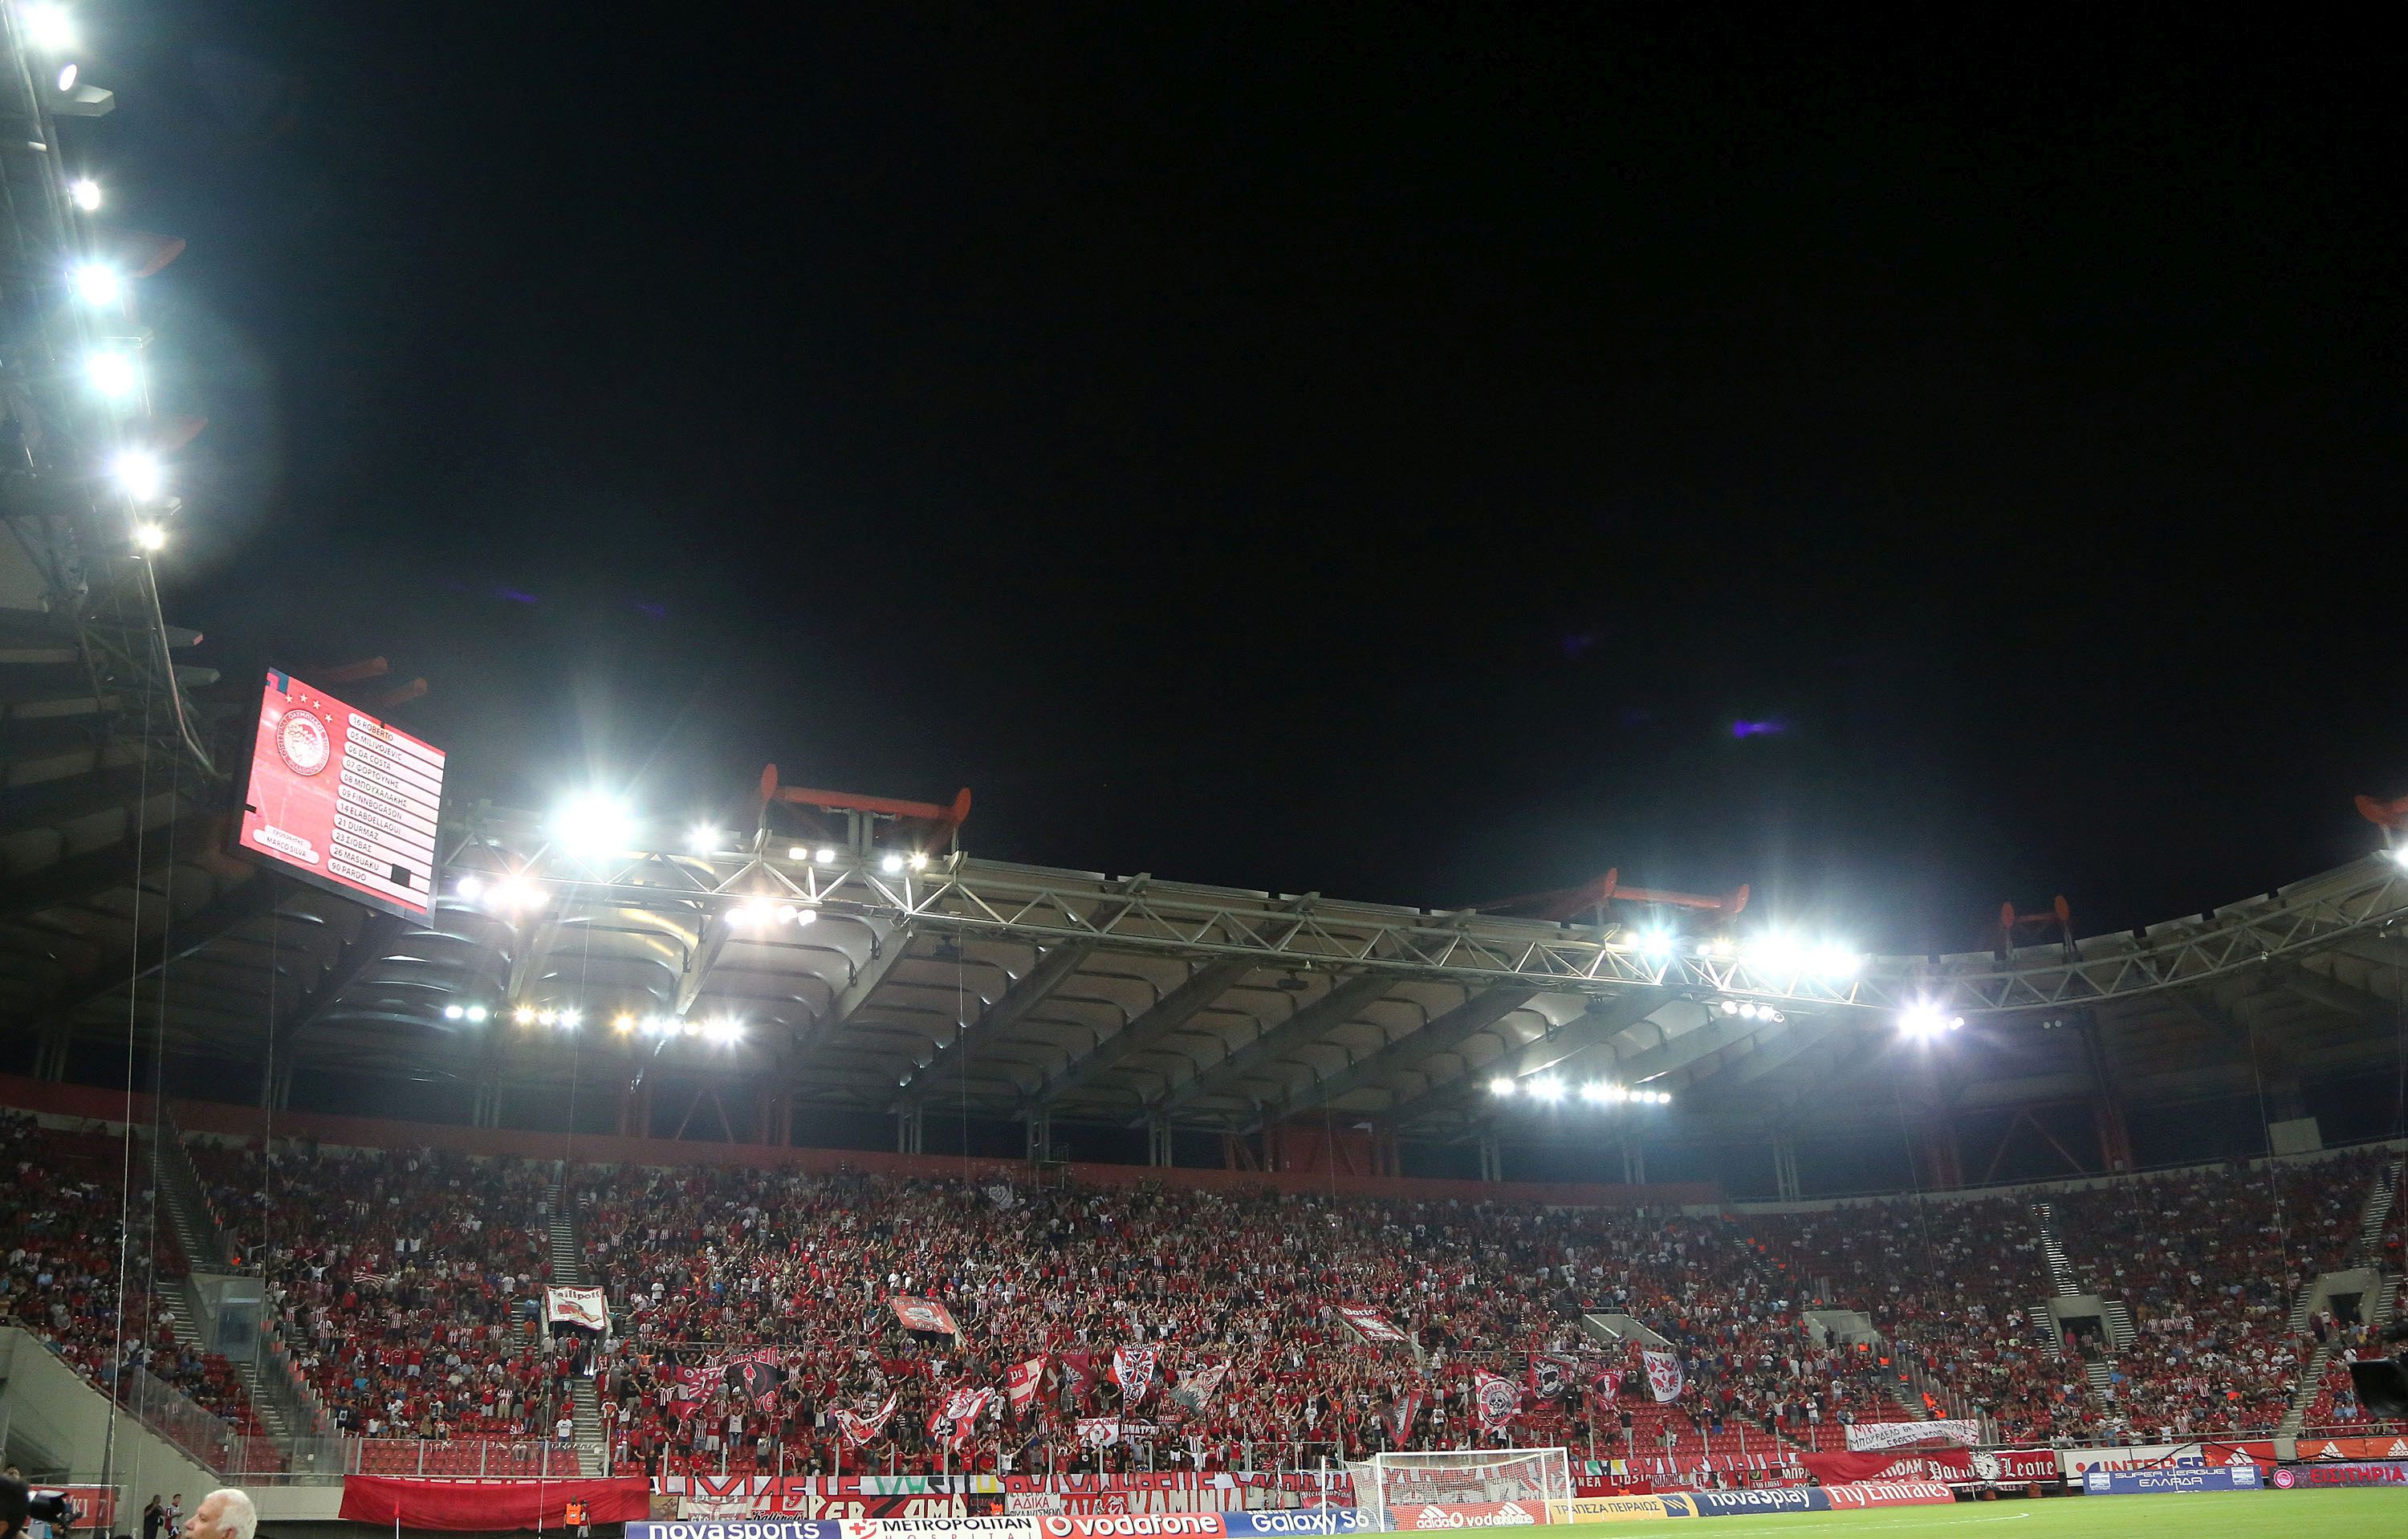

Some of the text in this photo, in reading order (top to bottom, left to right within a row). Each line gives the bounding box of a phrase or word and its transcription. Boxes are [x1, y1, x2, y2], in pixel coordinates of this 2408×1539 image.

[353, 717, 394, 742] 16 ROBERTO
[350, 731, 403, 761] 05 MILIVOJEVIC
[348, 745, 357, 755] 06
[369, 754, 392, 770] COSTA
[342, 788, 403, 820] 09 FINNBOGASON
[338, 818, 379, 841] 21 DURMAZ
[340, 803, 402, 835] 14 ELABDELLAOUI
[266, 837, 307, 858] MARCO SILVA
[336, 833, 372, 853] 23 ΣΙΟΒΑΣ
[333, 847, 380, 871] 26 MASUAKU
[332, 862, 367, 881] 90 PARDO
[2000, 1457, 2056, 1478] Leone
[2115, 1471, 2163, 1479] SUPER
[2311, 1466, 2406, 1483] ΕΙΣΙΤΗΡΙΑ
[2139, 1476, 2203, 1488] ΕΛΛΑΔΑ
[1012, 1496, 1050, 1510] ΑΔΙΚΑ
[1707, 1488, 1810, 1509] nova3play
[1825, 1480, 1950, 1506] Fly Emirates
[1554, 1500, 1660, 1515] ΤΡΑΠΕΖΑ ΠΕΙΡΑΙΩΣ
[883, 1517, 1031, 1532] METROPOLITAN
[1074, 1514, 1218, 1536] vodafone
[1251, 1510, 1369, 1535] Galaxy S6
